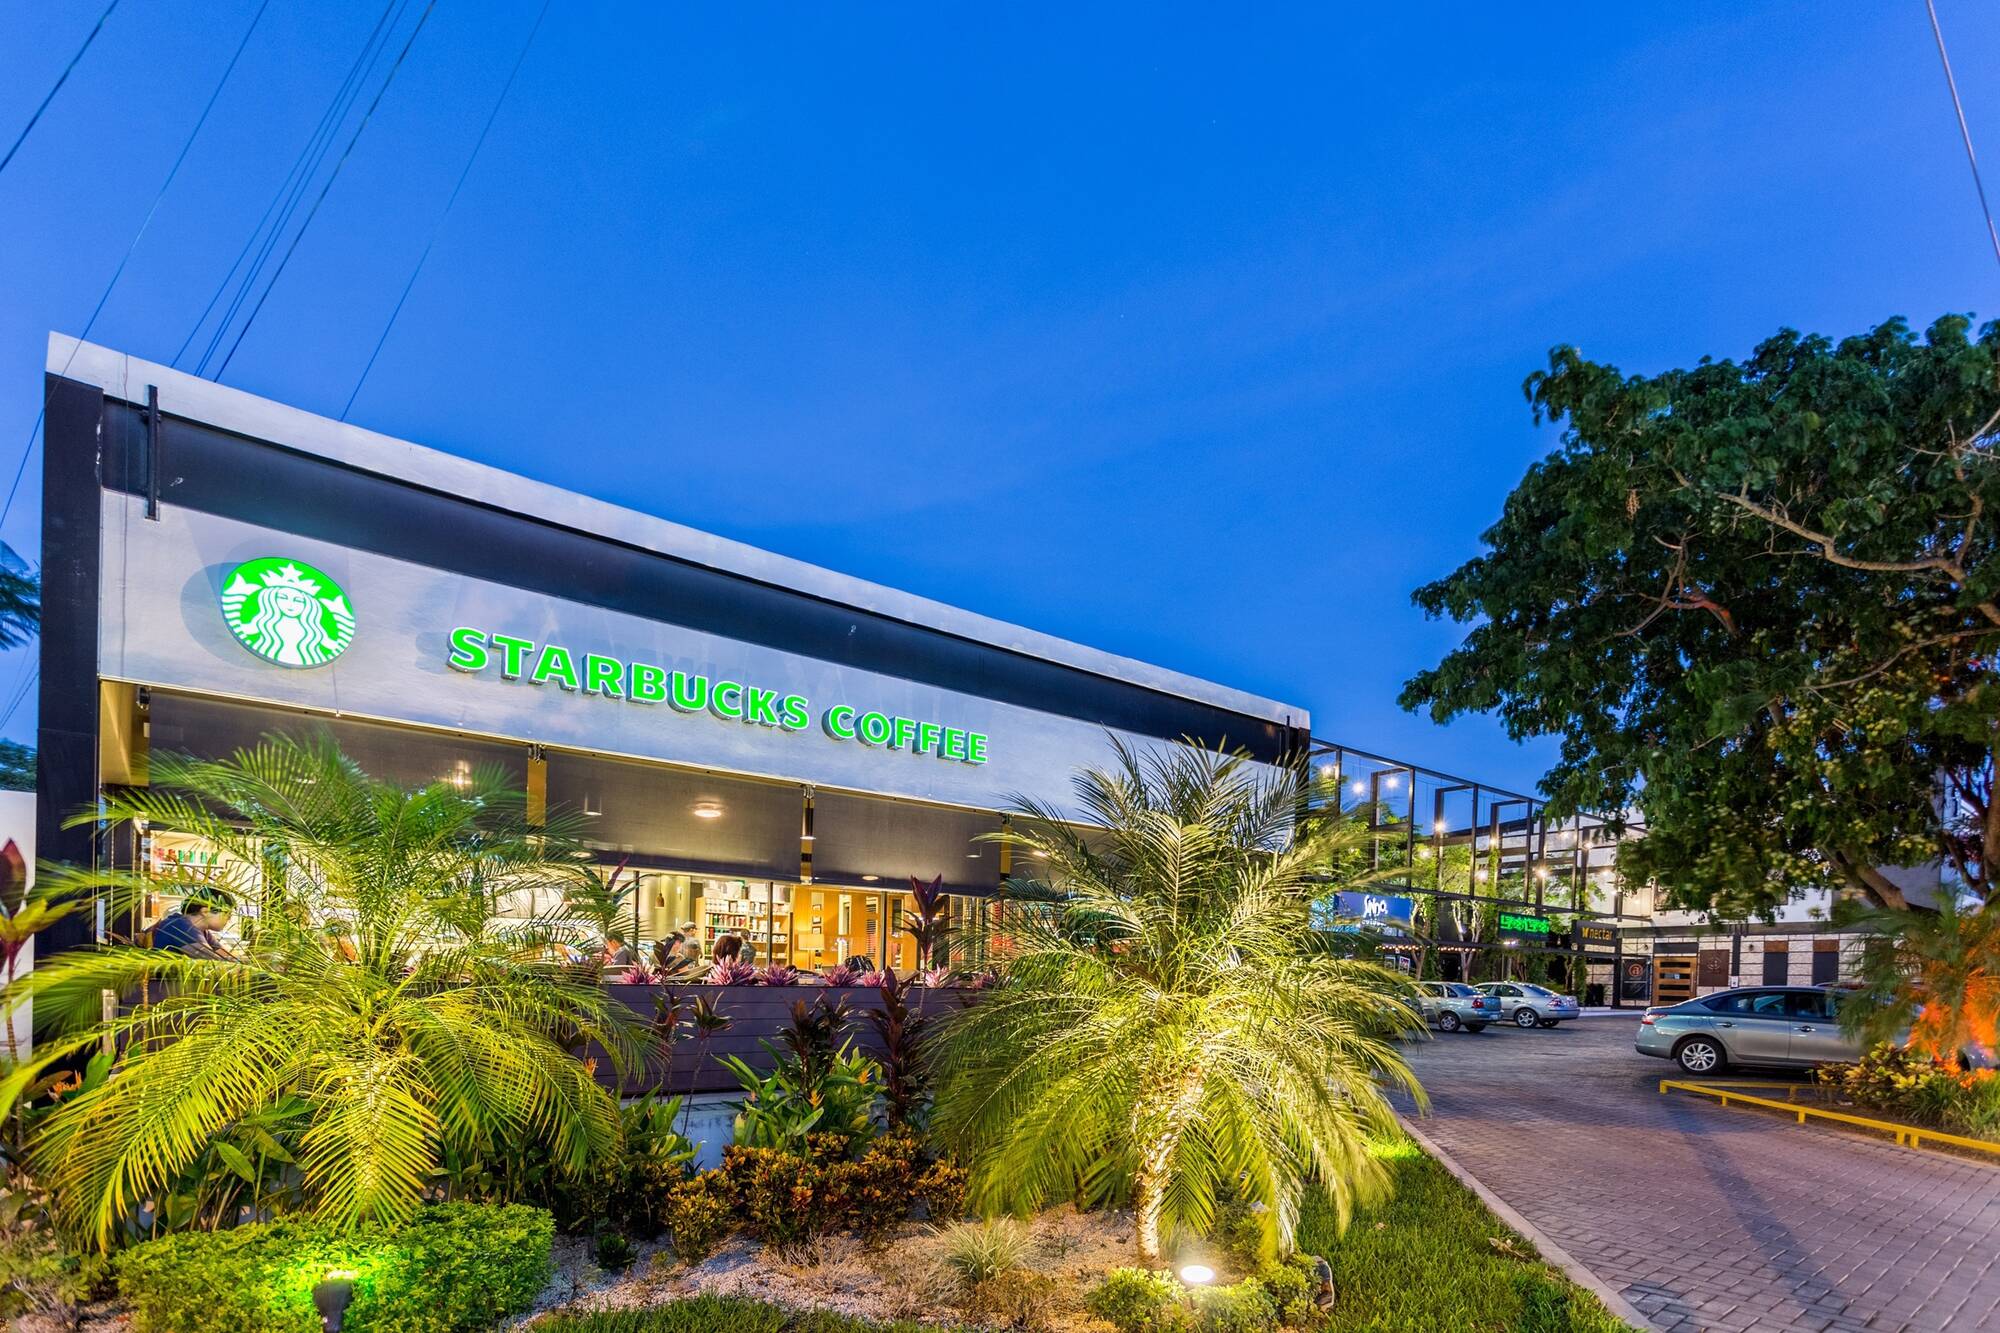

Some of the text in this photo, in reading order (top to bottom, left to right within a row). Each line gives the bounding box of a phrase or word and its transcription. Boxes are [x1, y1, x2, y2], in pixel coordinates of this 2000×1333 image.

[447, 626, 989, 765] STARBUCKS COFFEE
[1589, 927, 1614, 941] nectar
